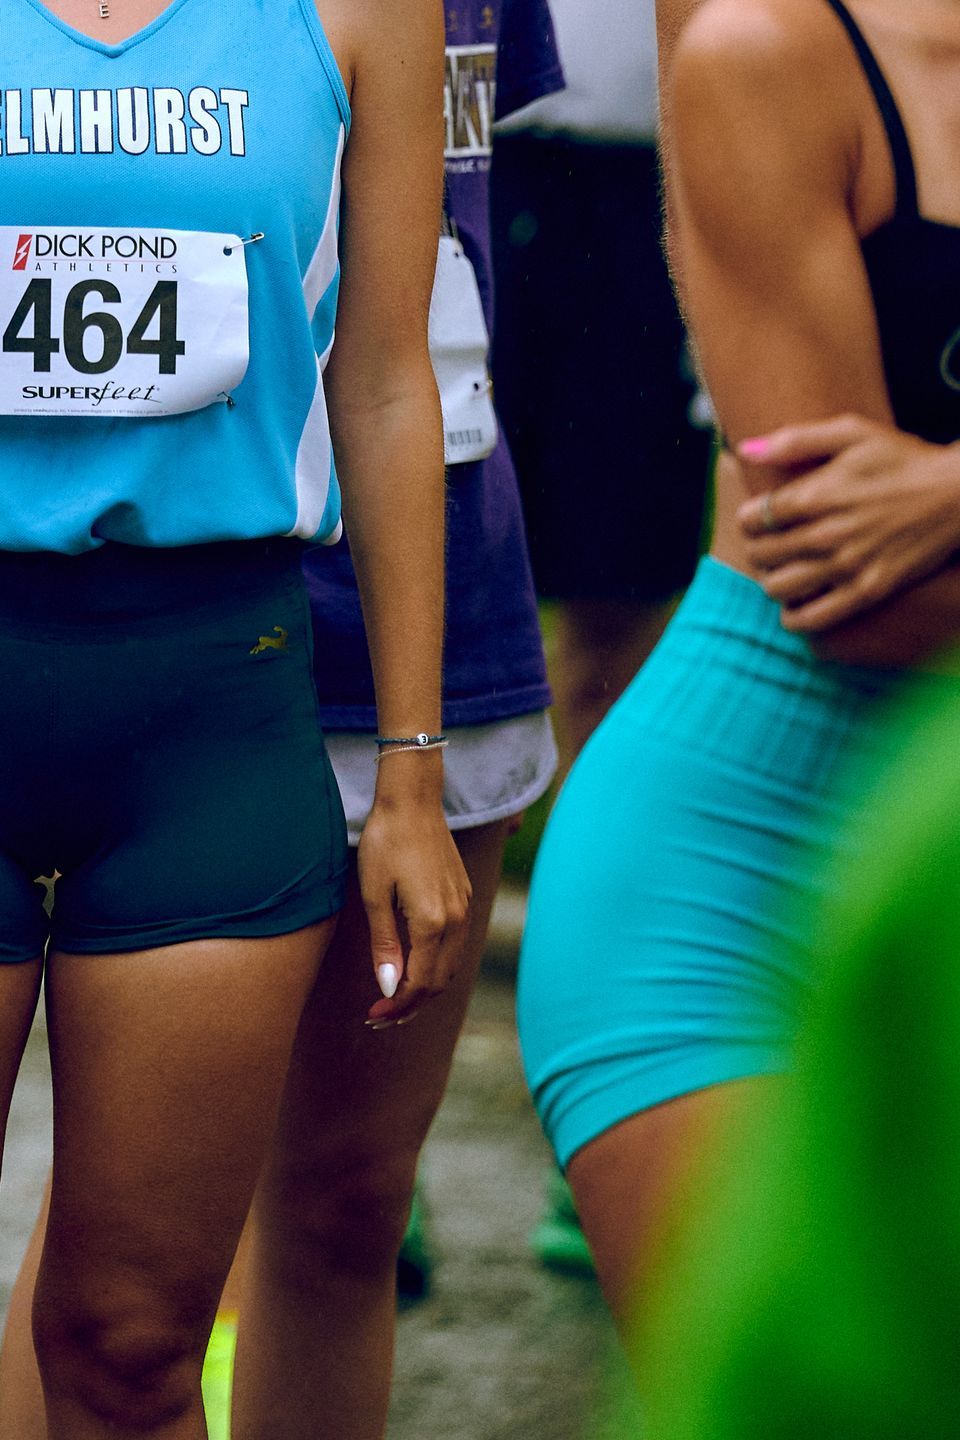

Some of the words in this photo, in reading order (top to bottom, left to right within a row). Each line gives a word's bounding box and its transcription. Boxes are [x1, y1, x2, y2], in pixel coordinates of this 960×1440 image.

[35, 234, 95, 258] DICK
[101, 235, 178, 260] POND
[35, 262, 178, 274] ATHLETICS
[2, 277, 186, 375] 464
[22, 380, 162, 407] SUPERfeet
